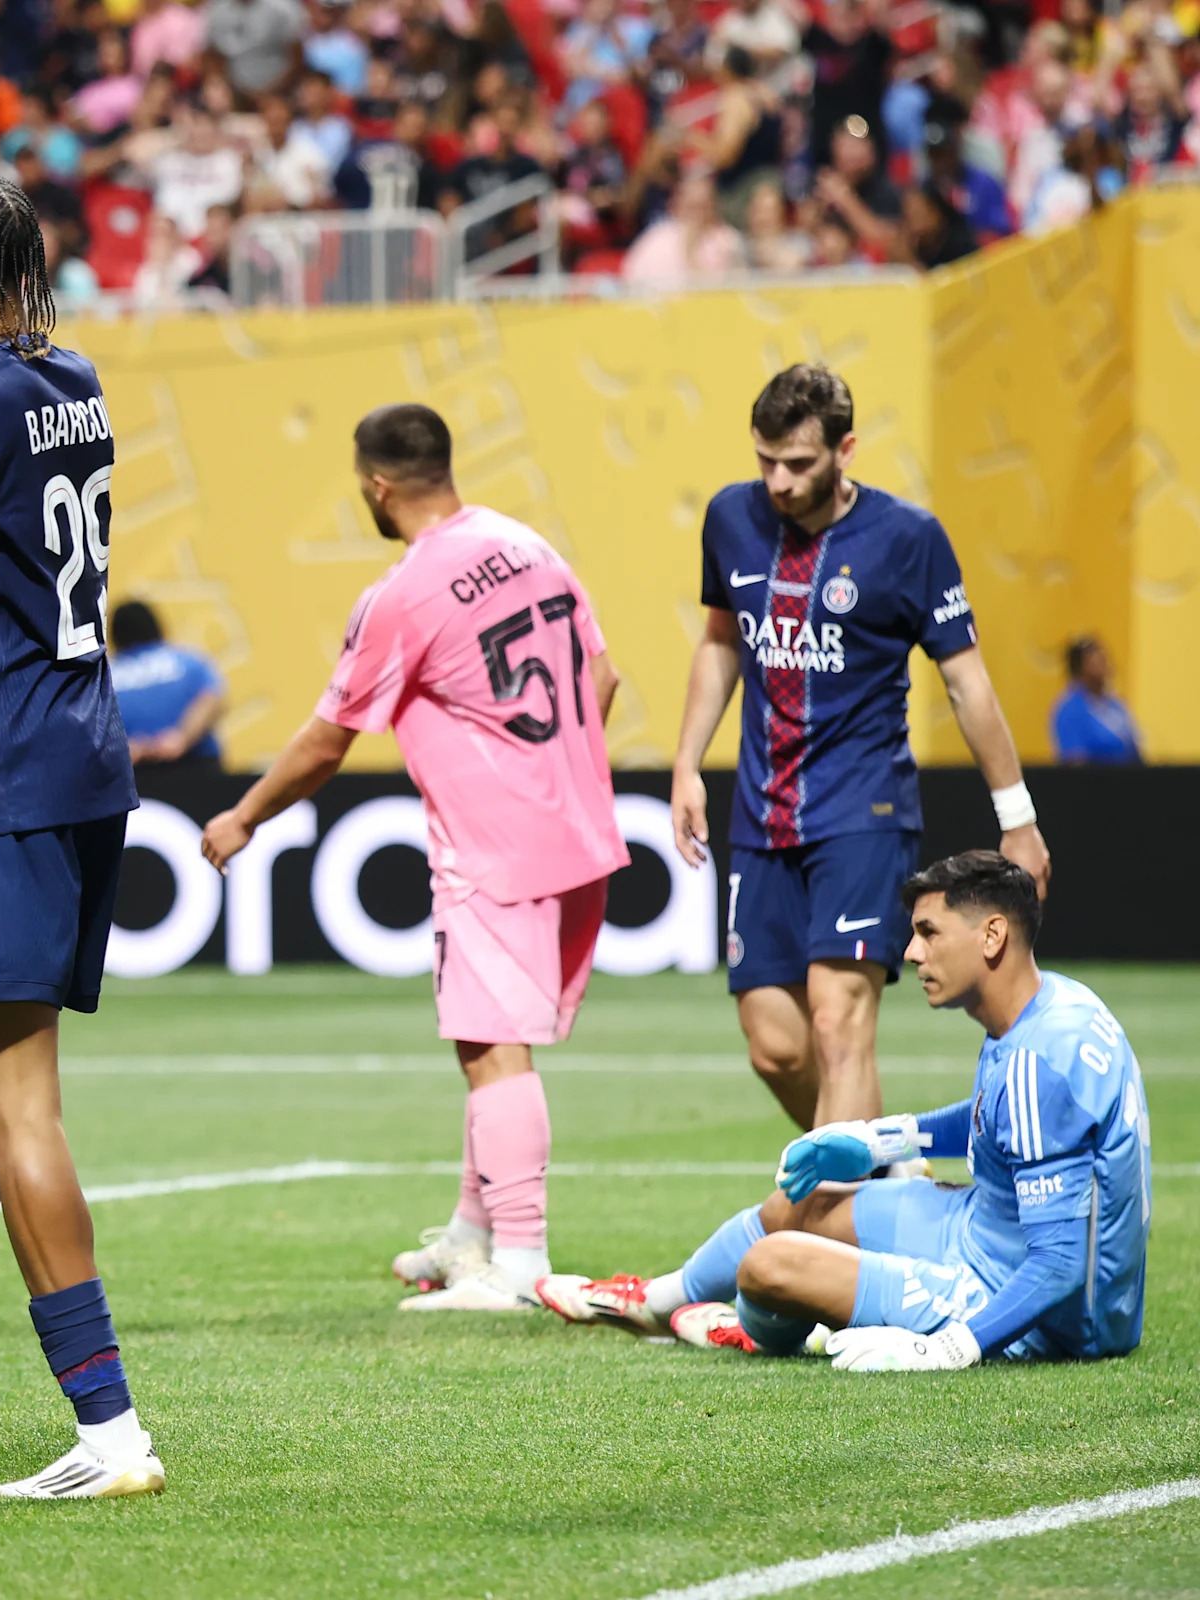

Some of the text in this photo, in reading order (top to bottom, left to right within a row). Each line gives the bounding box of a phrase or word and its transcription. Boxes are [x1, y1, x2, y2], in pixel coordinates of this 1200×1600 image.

[737, 609, 844, 654] QATAR
[478, 592, 585, 744] 57
[756, 645, 846, 674] AIRWAYS
